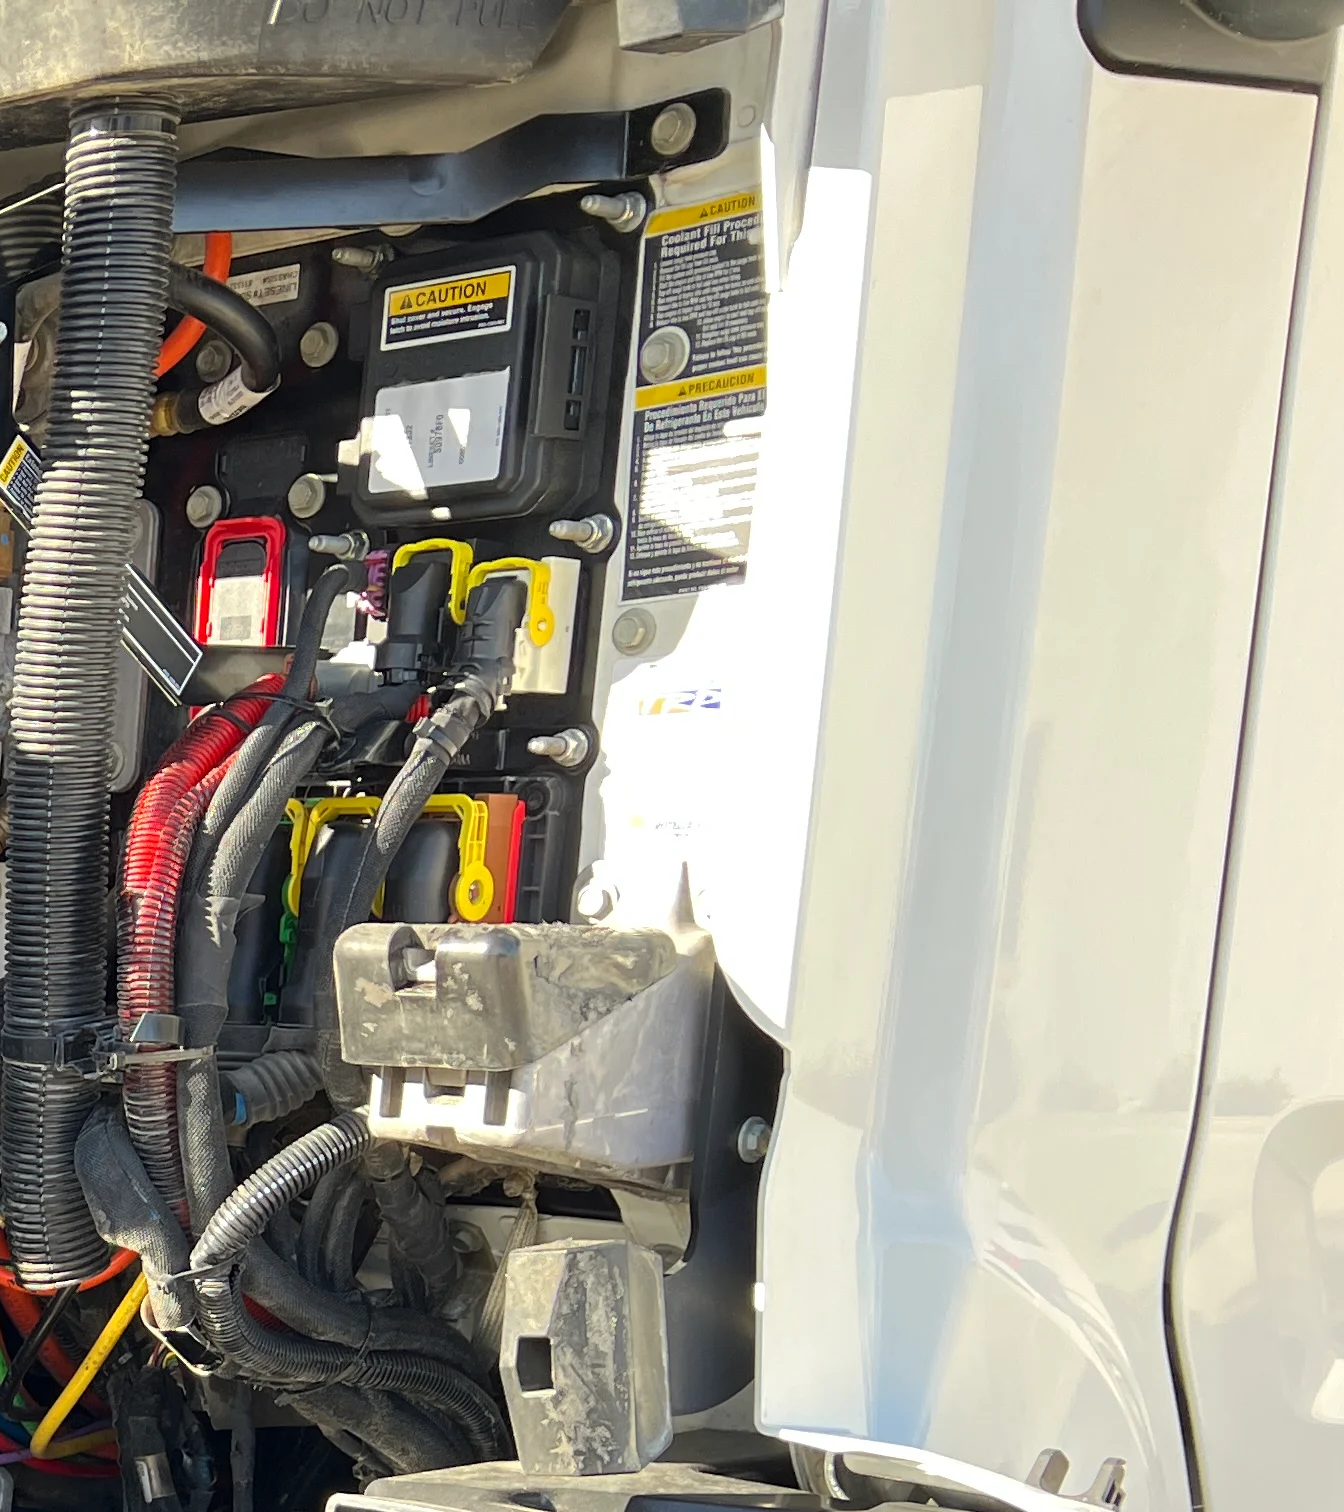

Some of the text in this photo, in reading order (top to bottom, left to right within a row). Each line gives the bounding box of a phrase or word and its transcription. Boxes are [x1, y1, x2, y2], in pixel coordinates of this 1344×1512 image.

[710, 196, 755, 216] CAUTION
[416, 280, 487, 307] CAUTION
[0, 444, 24, 483] CAUTION
